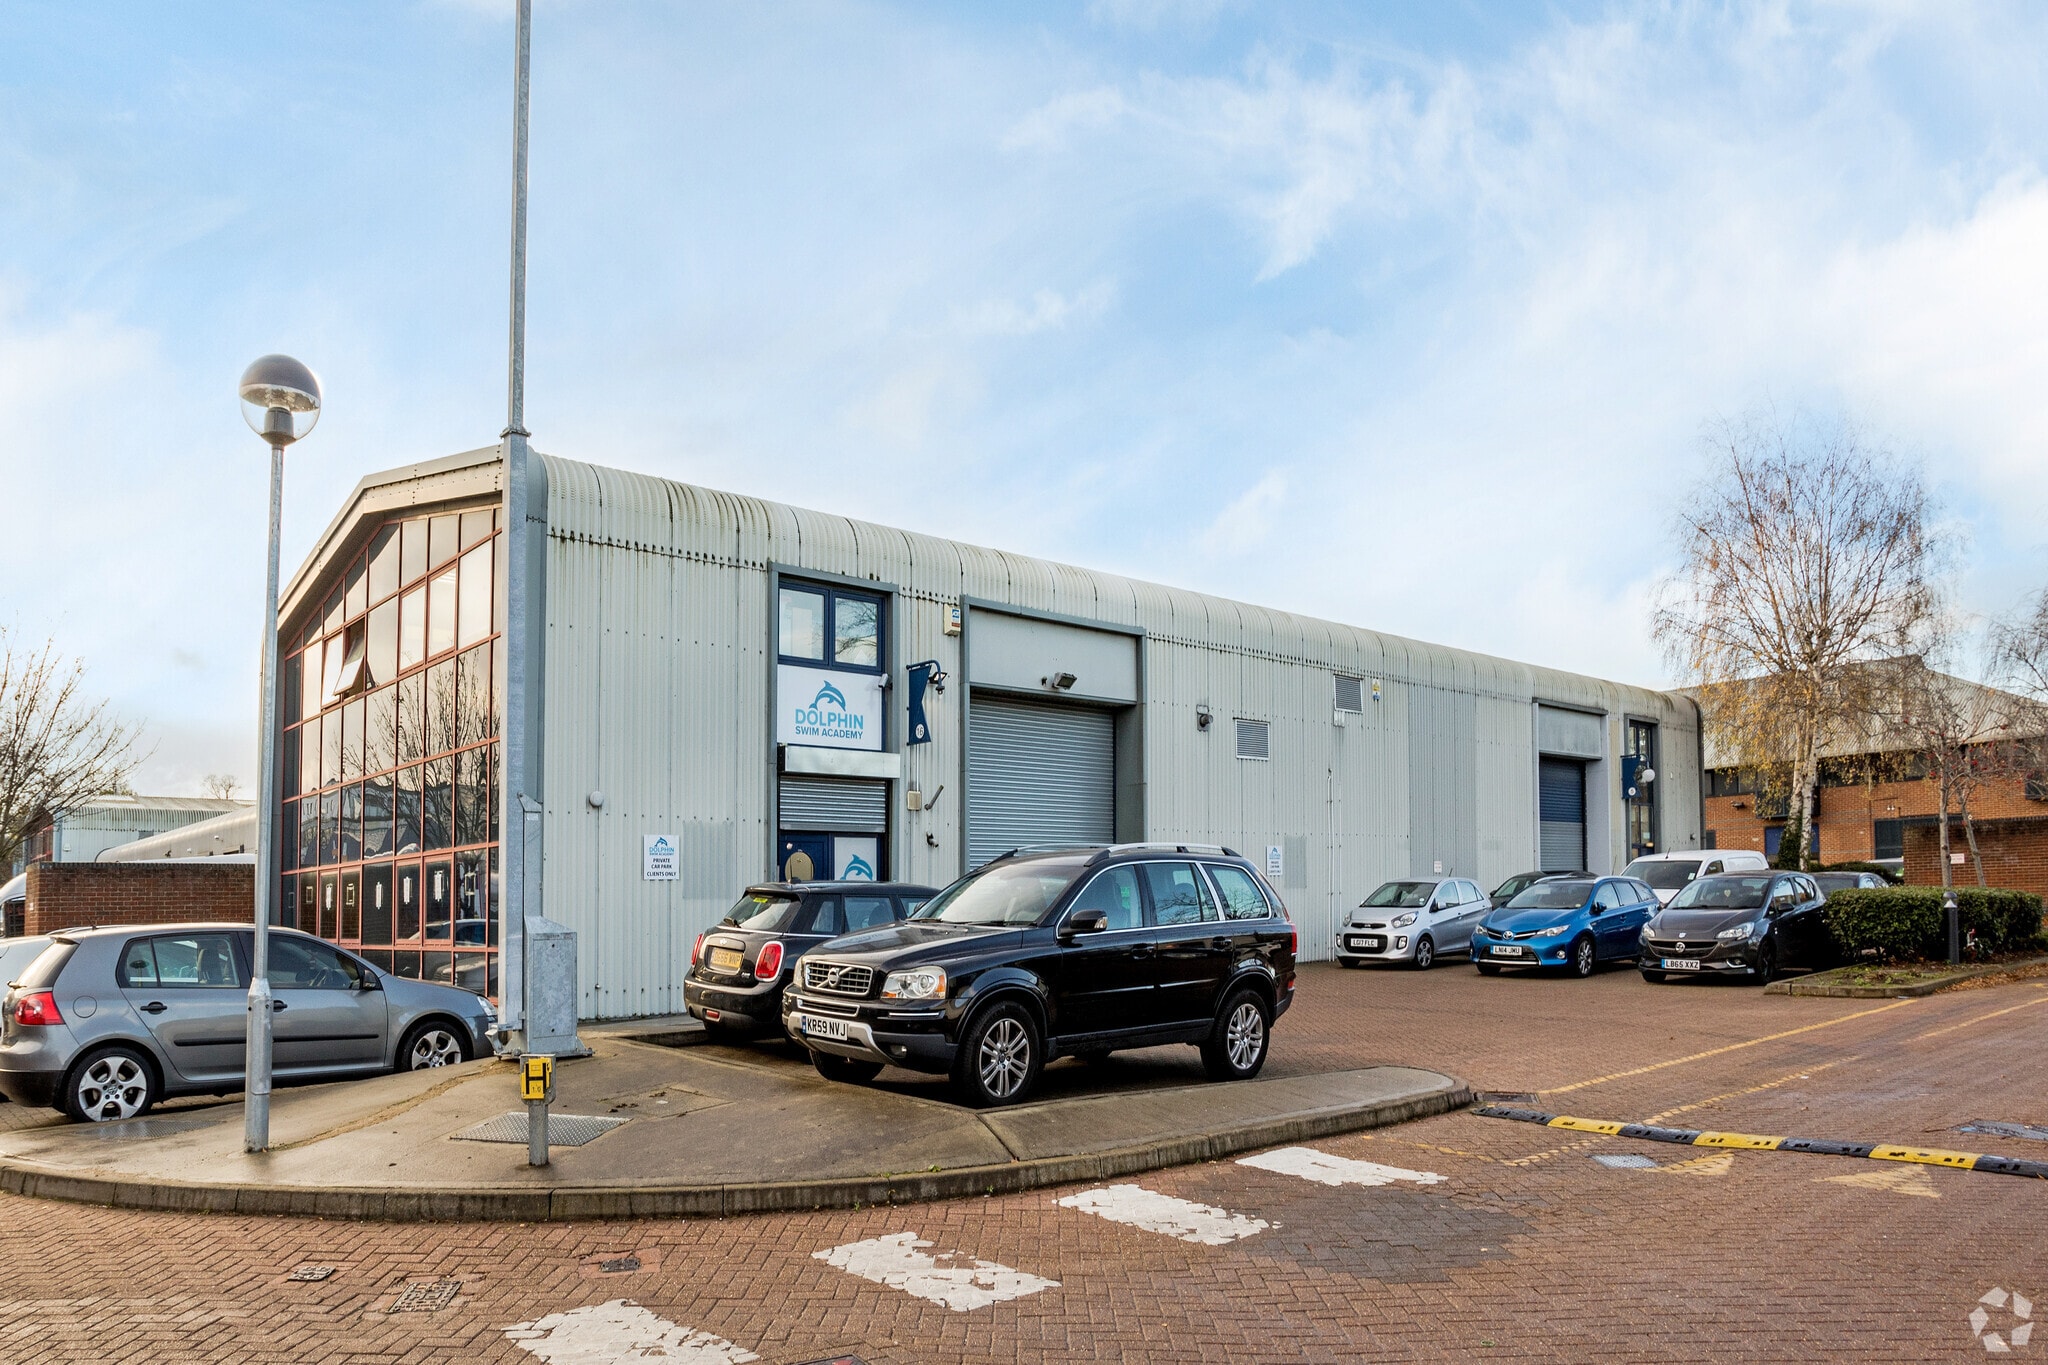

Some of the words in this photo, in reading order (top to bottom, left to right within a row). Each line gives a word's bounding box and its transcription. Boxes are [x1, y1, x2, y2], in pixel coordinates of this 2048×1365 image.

[795, 708, 863, 730] DOLPHIN
[795, 725, 819, 736] SWIM
[821, 728, 863, 739] ACADEMY
[807, 1018, 827, 1034] KR59
[829, 1021, 846, 1037] NVJ
[526, 1063, 546, 1094] H
